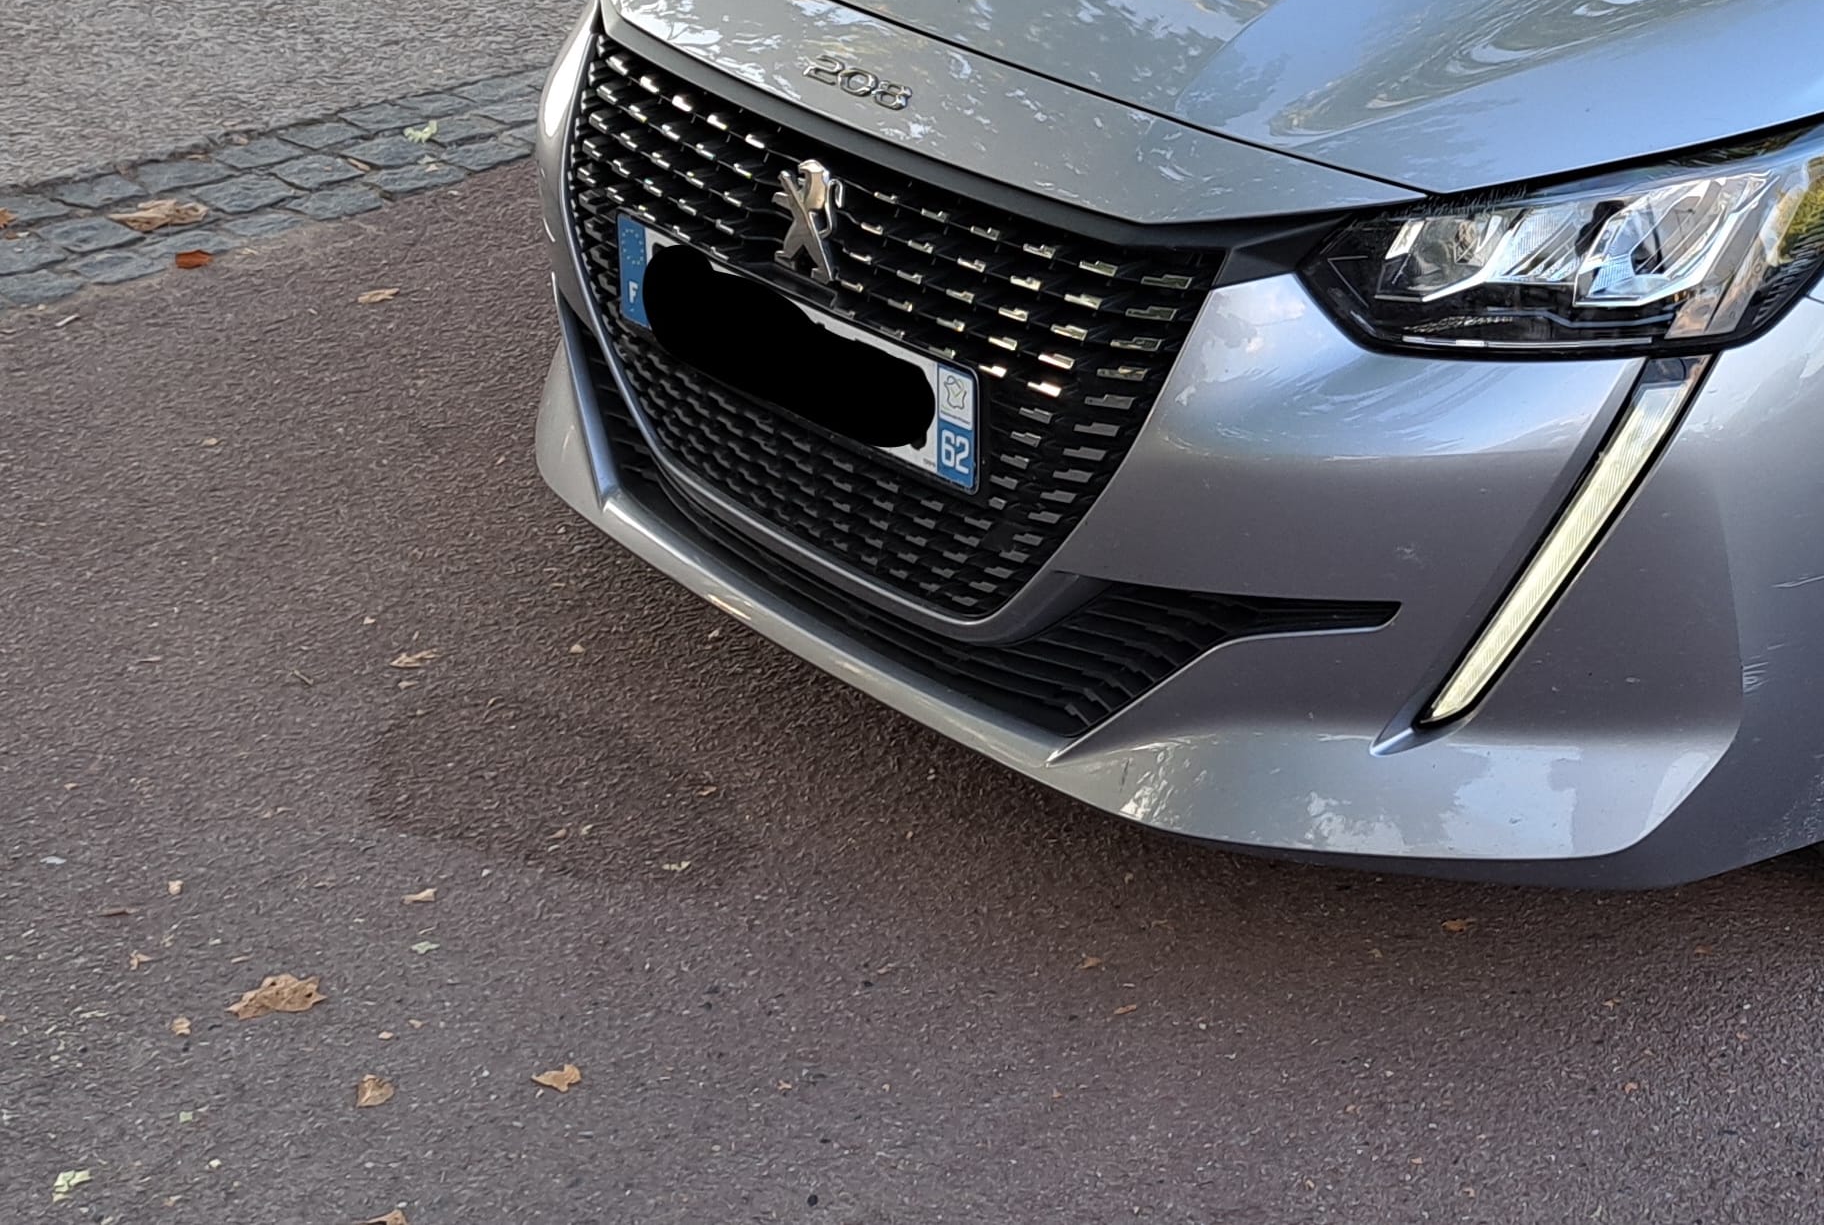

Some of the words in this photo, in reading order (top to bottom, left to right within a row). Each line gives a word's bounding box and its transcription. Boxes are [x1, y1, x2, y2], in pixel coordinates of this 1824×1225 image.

[803, 55, 912, 110] 208
[628, 280, 639, 304] F
[941, 429, 970, 474] 62
